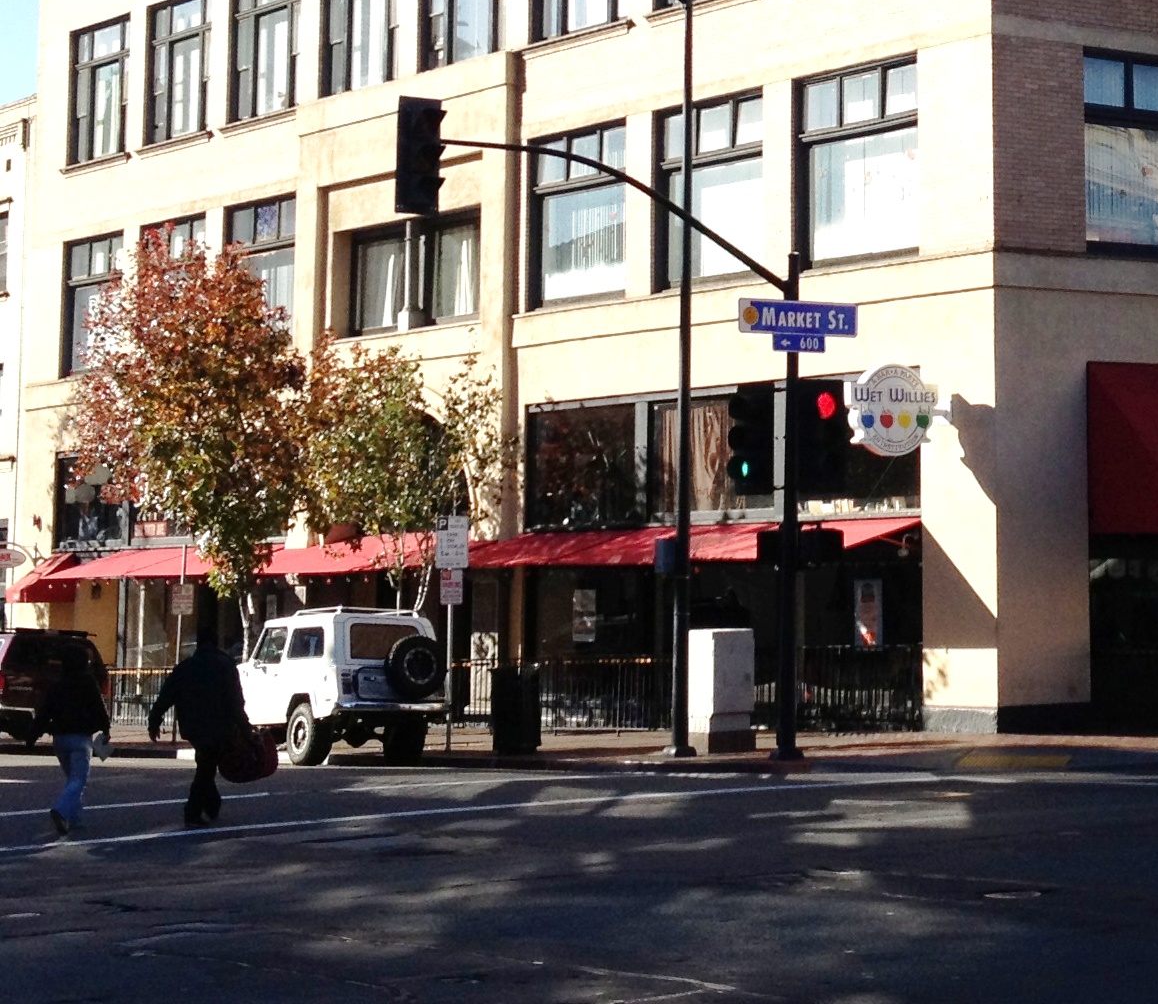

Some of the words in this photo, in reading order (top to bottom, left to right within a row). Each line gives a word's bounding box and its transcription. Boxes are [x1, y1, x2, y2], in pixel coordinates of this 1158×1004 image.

[761, 307, 821, 329] MARKET
[828, 310, 849, 330] ST.
[800, 337, 819, 350] 600
[854, 387, 883, 403] WET
[439, 518, 447, 529] P
